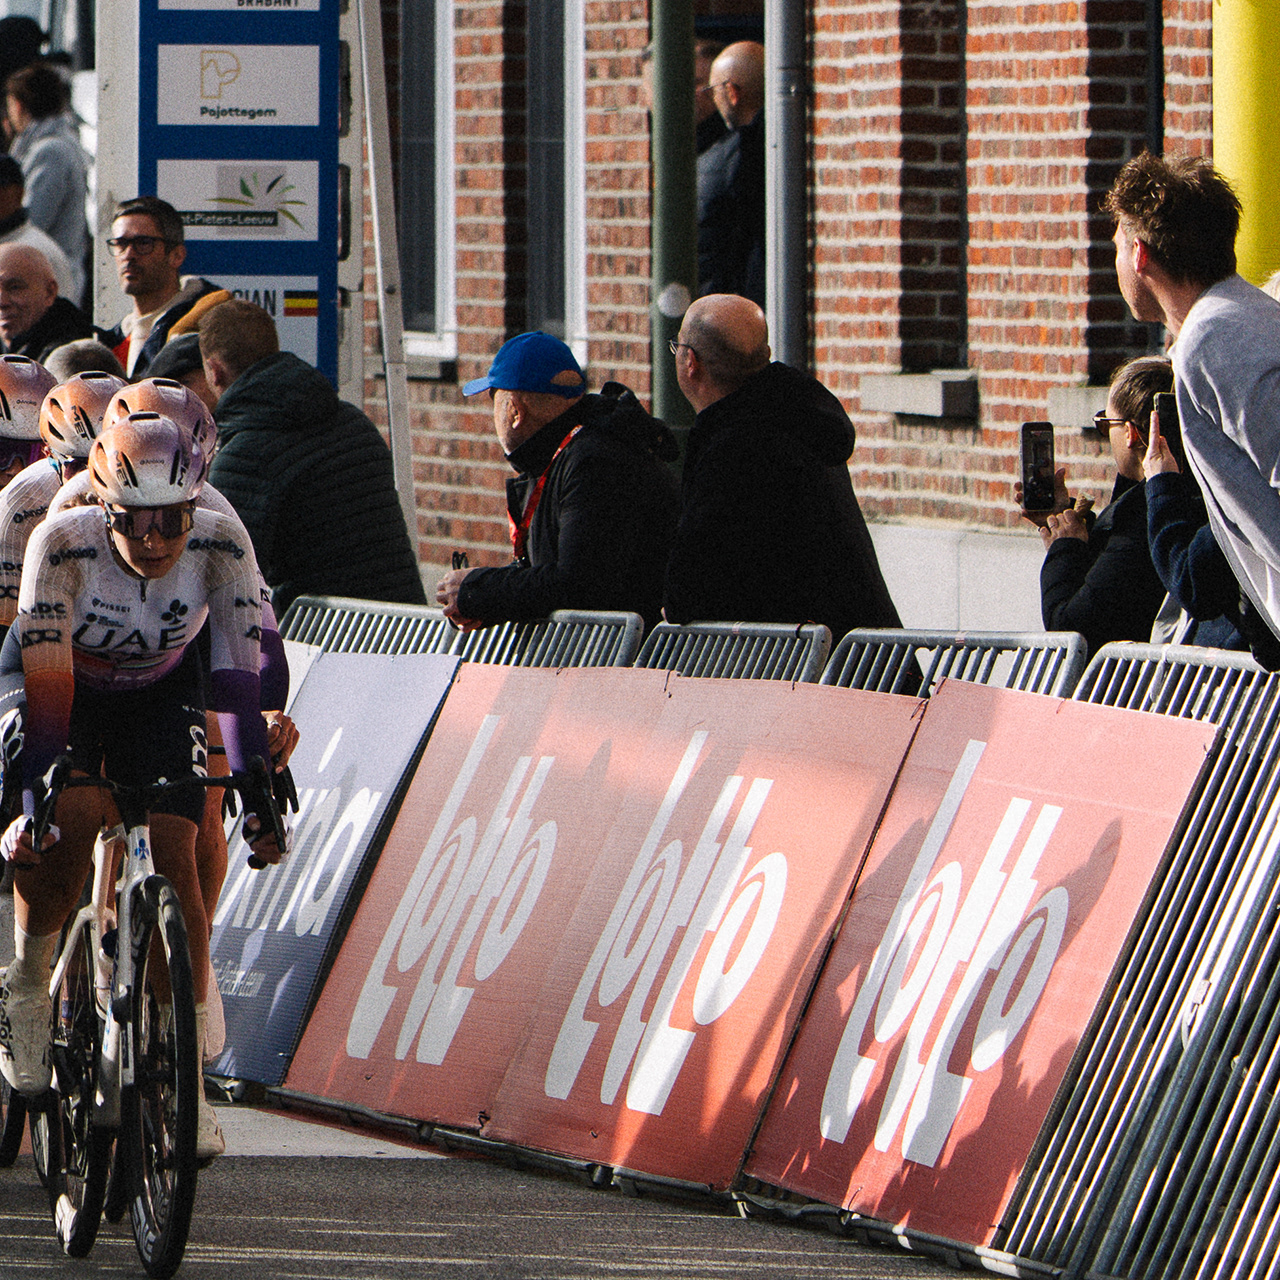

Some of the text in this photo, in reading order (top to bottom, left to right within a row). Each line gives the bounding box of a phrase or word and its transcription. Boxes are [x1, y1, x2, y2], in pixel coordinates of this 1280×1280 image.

[200, 106, 278, 120] Pajottegem
[72, 623, 187, 651] UAE
[346, 715, 558, 1066] lotto
[544, 730, 788, 1117] lotto
[820, 739, 1069, 1168] lotto
